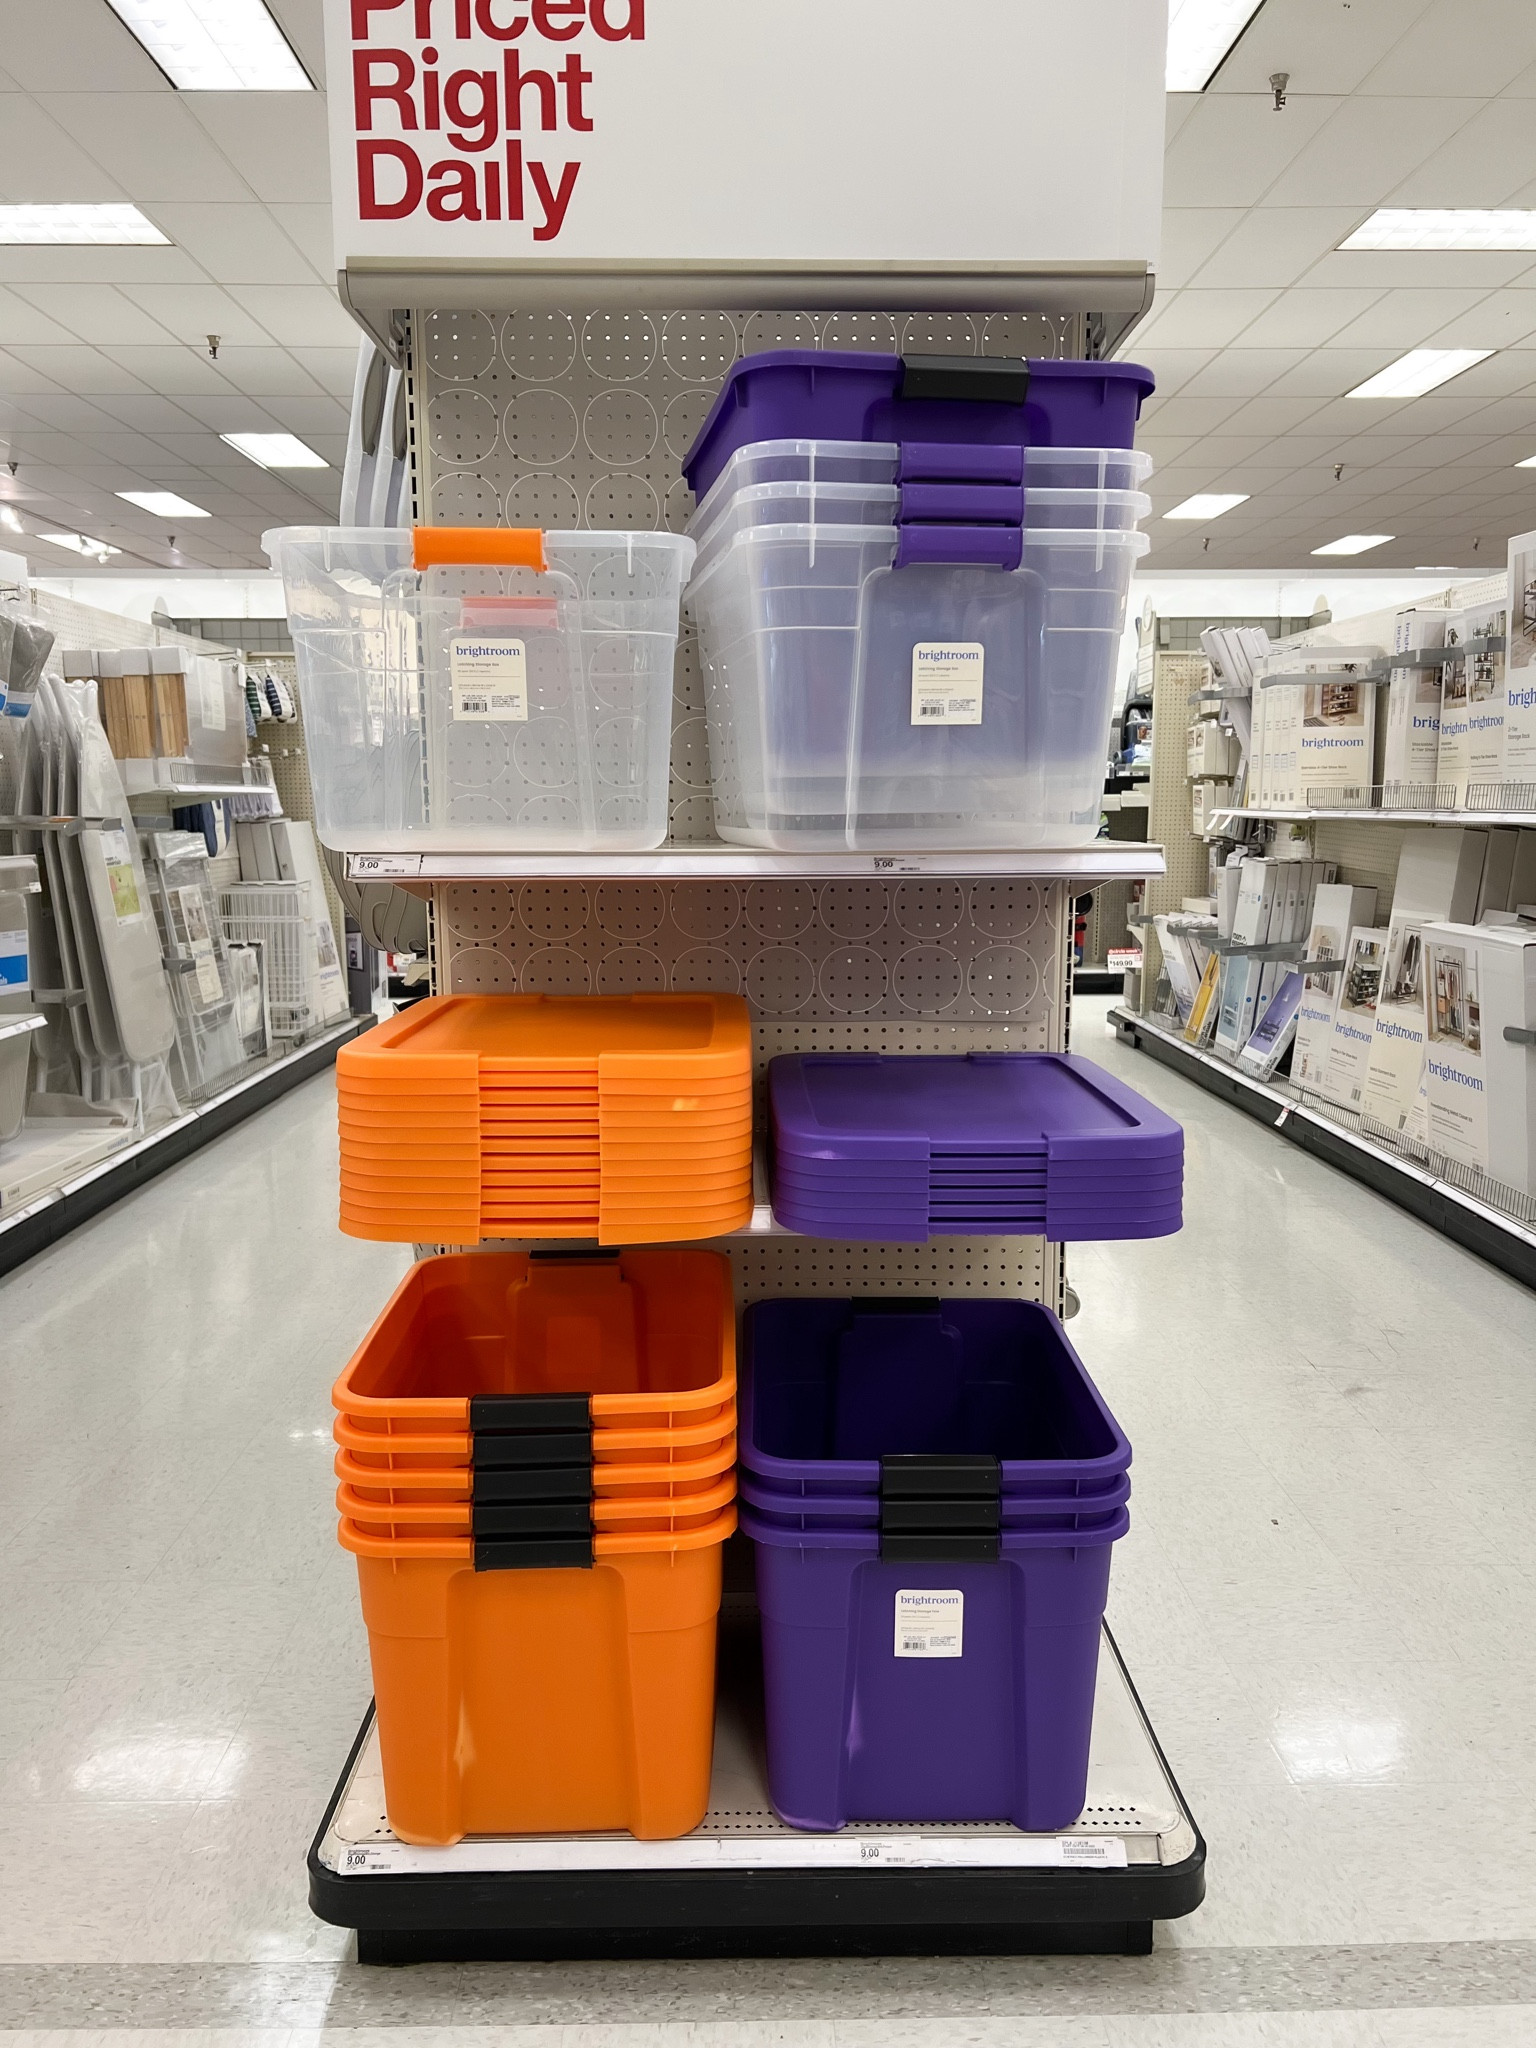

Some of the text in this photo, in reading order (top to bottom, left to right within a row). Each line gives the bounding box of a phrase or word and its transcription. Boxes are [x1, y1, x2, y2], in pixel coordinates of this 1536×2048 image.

[351, 46, 594, 153] Right
[356, 138, 582, 241] Daily
[455, 645, 520, 658] brightroom
[918, 650, 979, 662] brightroom
[1469, 715, 1504, 731] brightroo
[1301, 737, 1364, 750] brightroom
[359, 861, 379, 869] 9.00
[1301, 1005, 1331, 1023] brightroom
[1376, 1018, 1423, 1043] brightroom
[1428, 1058, 1483, 1092] brightroom
[900, 1595, 959, 1606] brightroom
[860, 1848, 880, 1858] 9.00
[346, 1855, 366, 1865] 9.00
